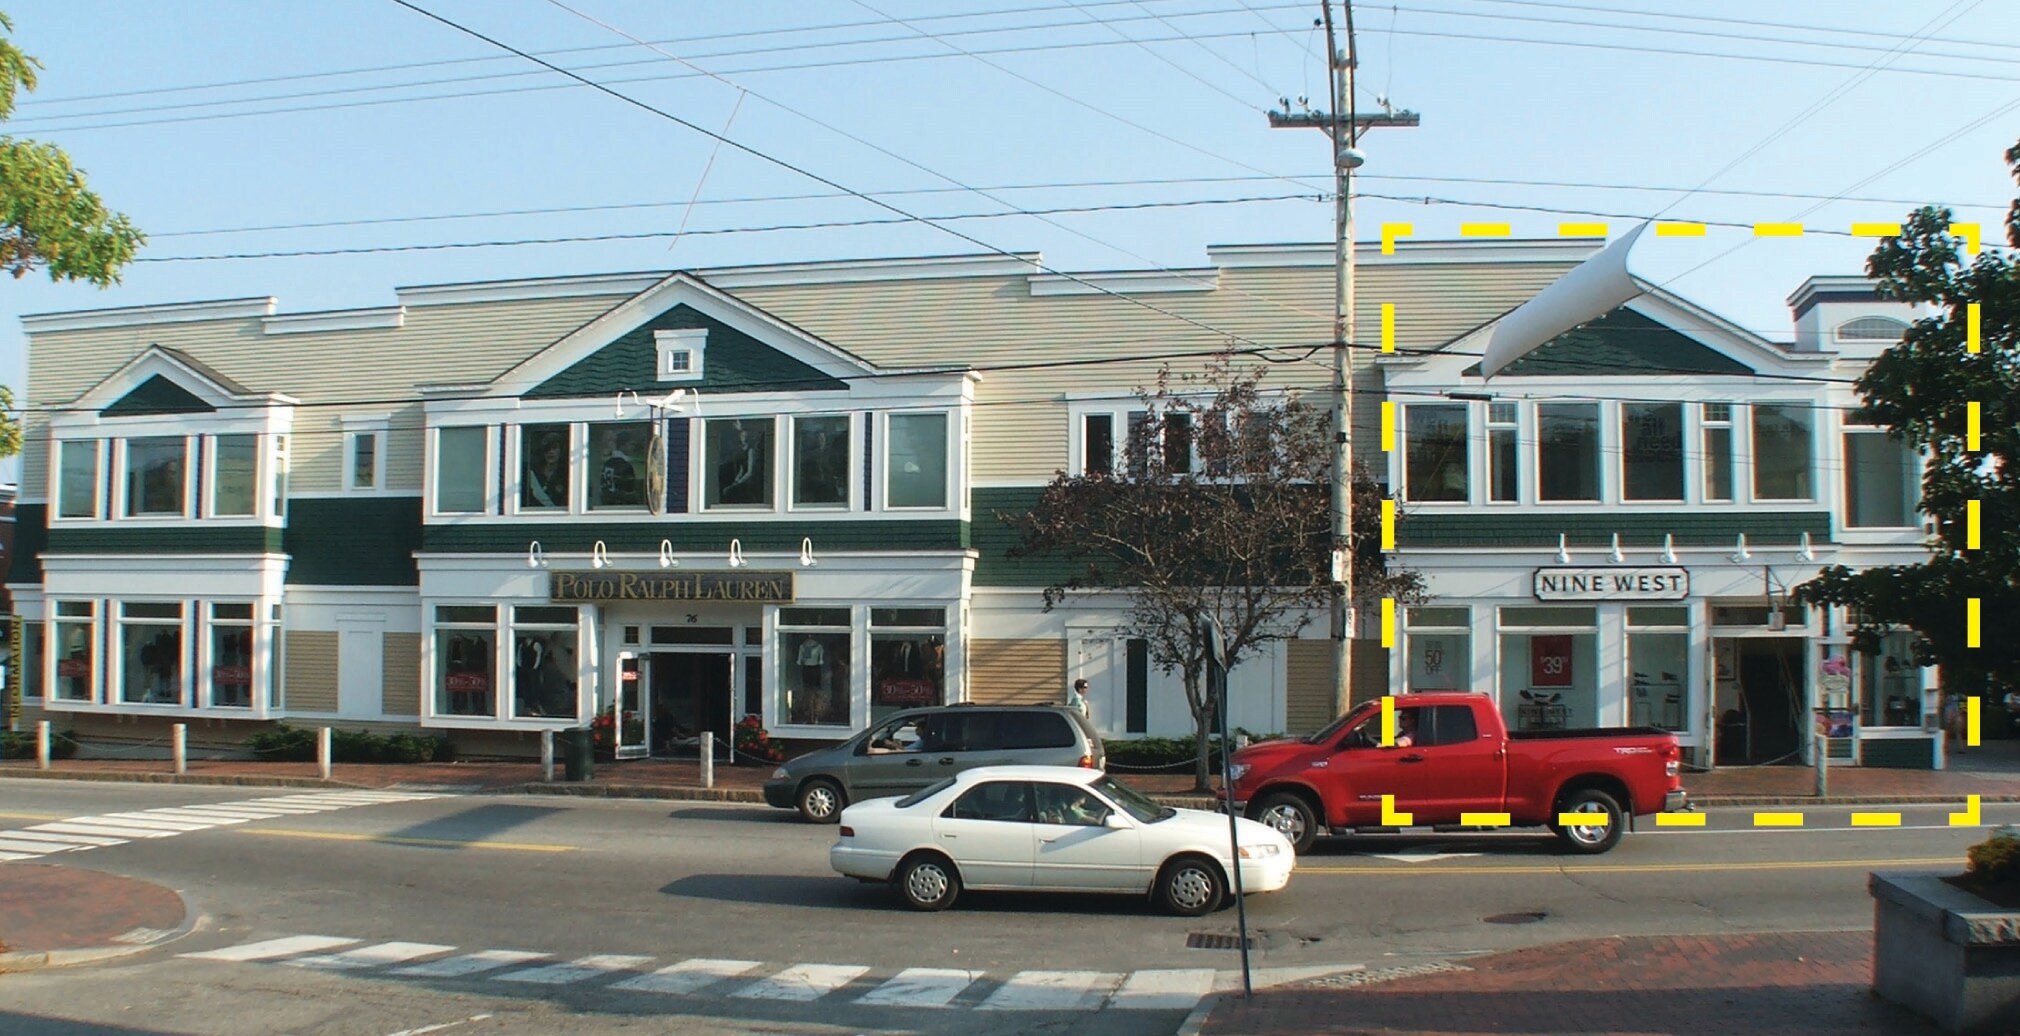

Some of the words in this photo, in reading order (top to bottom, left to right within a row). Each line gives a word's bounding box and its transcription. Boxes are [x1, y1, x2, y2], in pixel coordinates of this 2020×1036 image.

[557, 573, 614, 599] POLO
[619, 573, 690, 599] RALPH
[695, 574, 784, 599] LAUREN
[1542, 576, 1603, 591] NINE
[1614, 576, 1681, 591] WEST
[686, 614, 698, 623] 76
[11, 619, 20, 718] INFORMATION
